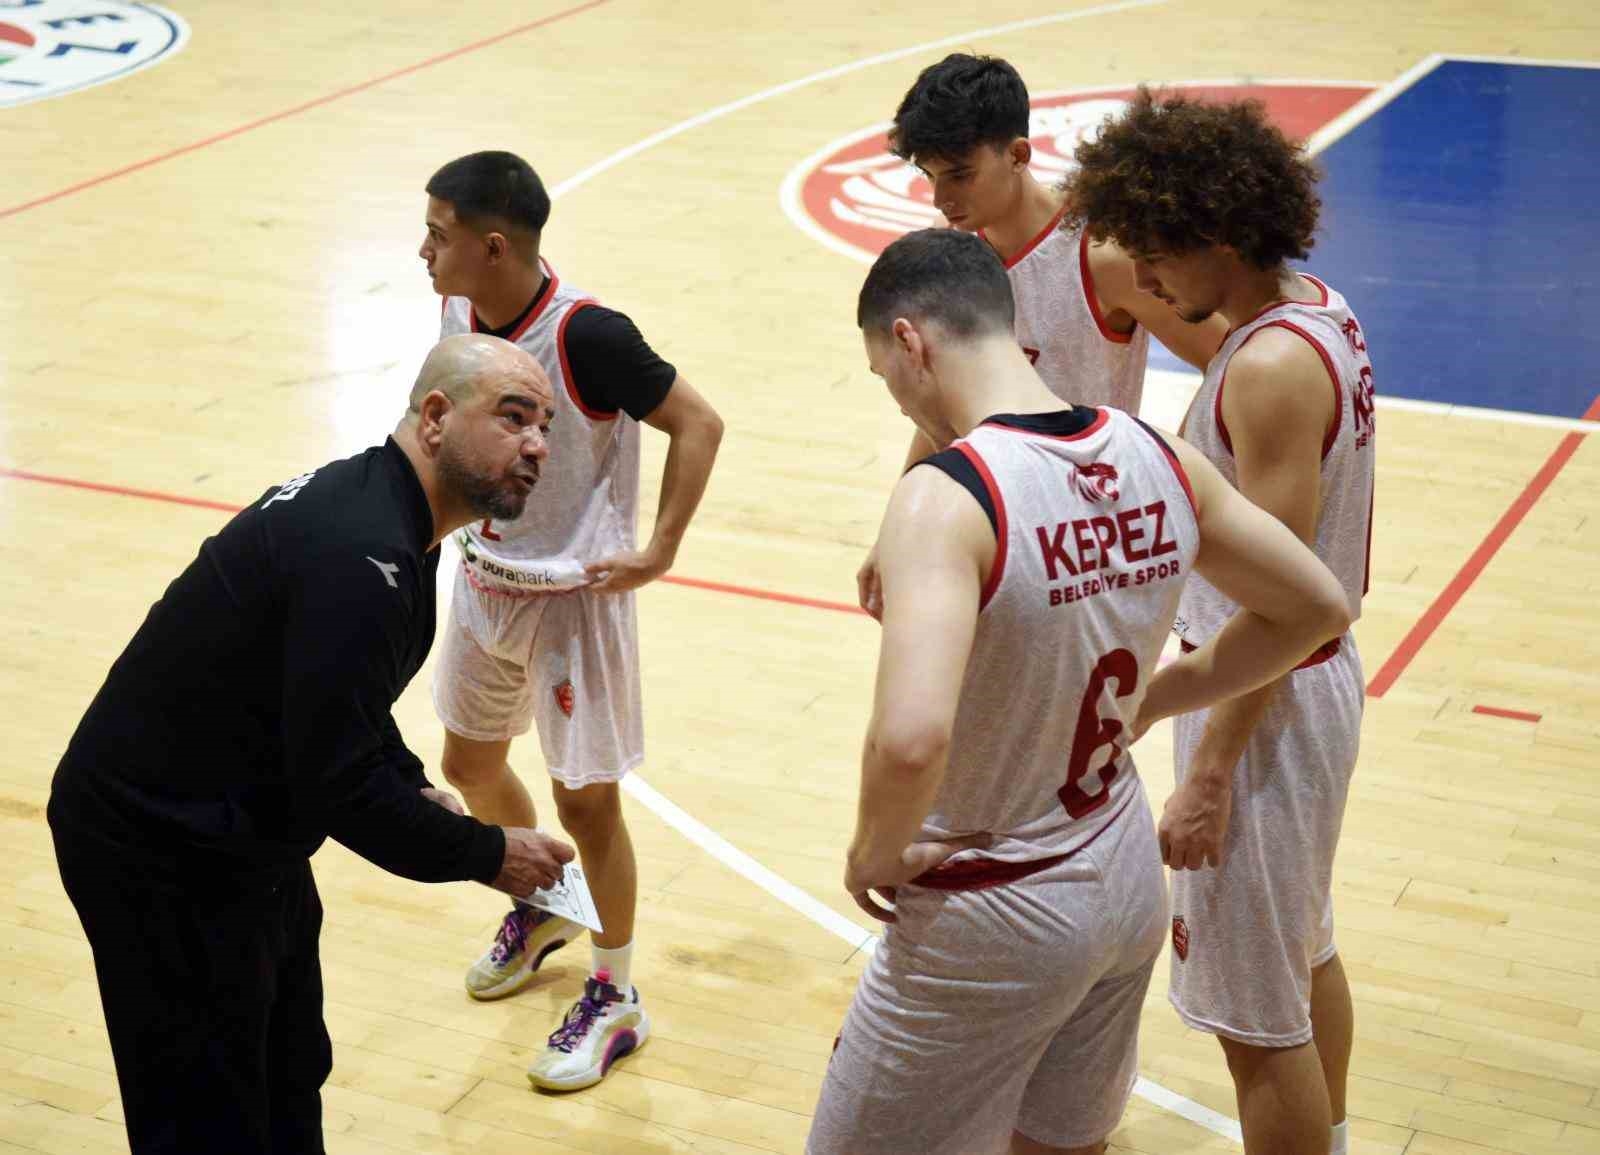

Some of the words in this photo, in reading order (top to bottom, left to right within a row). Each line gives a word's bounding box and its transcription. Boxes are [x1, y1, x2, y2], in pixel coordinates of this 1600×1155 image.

[1036, 499, 1178, 581] KEPEZ
[1134, 559, 1181, 585] SPOR
[1057, 648, 1138, 820] 6
